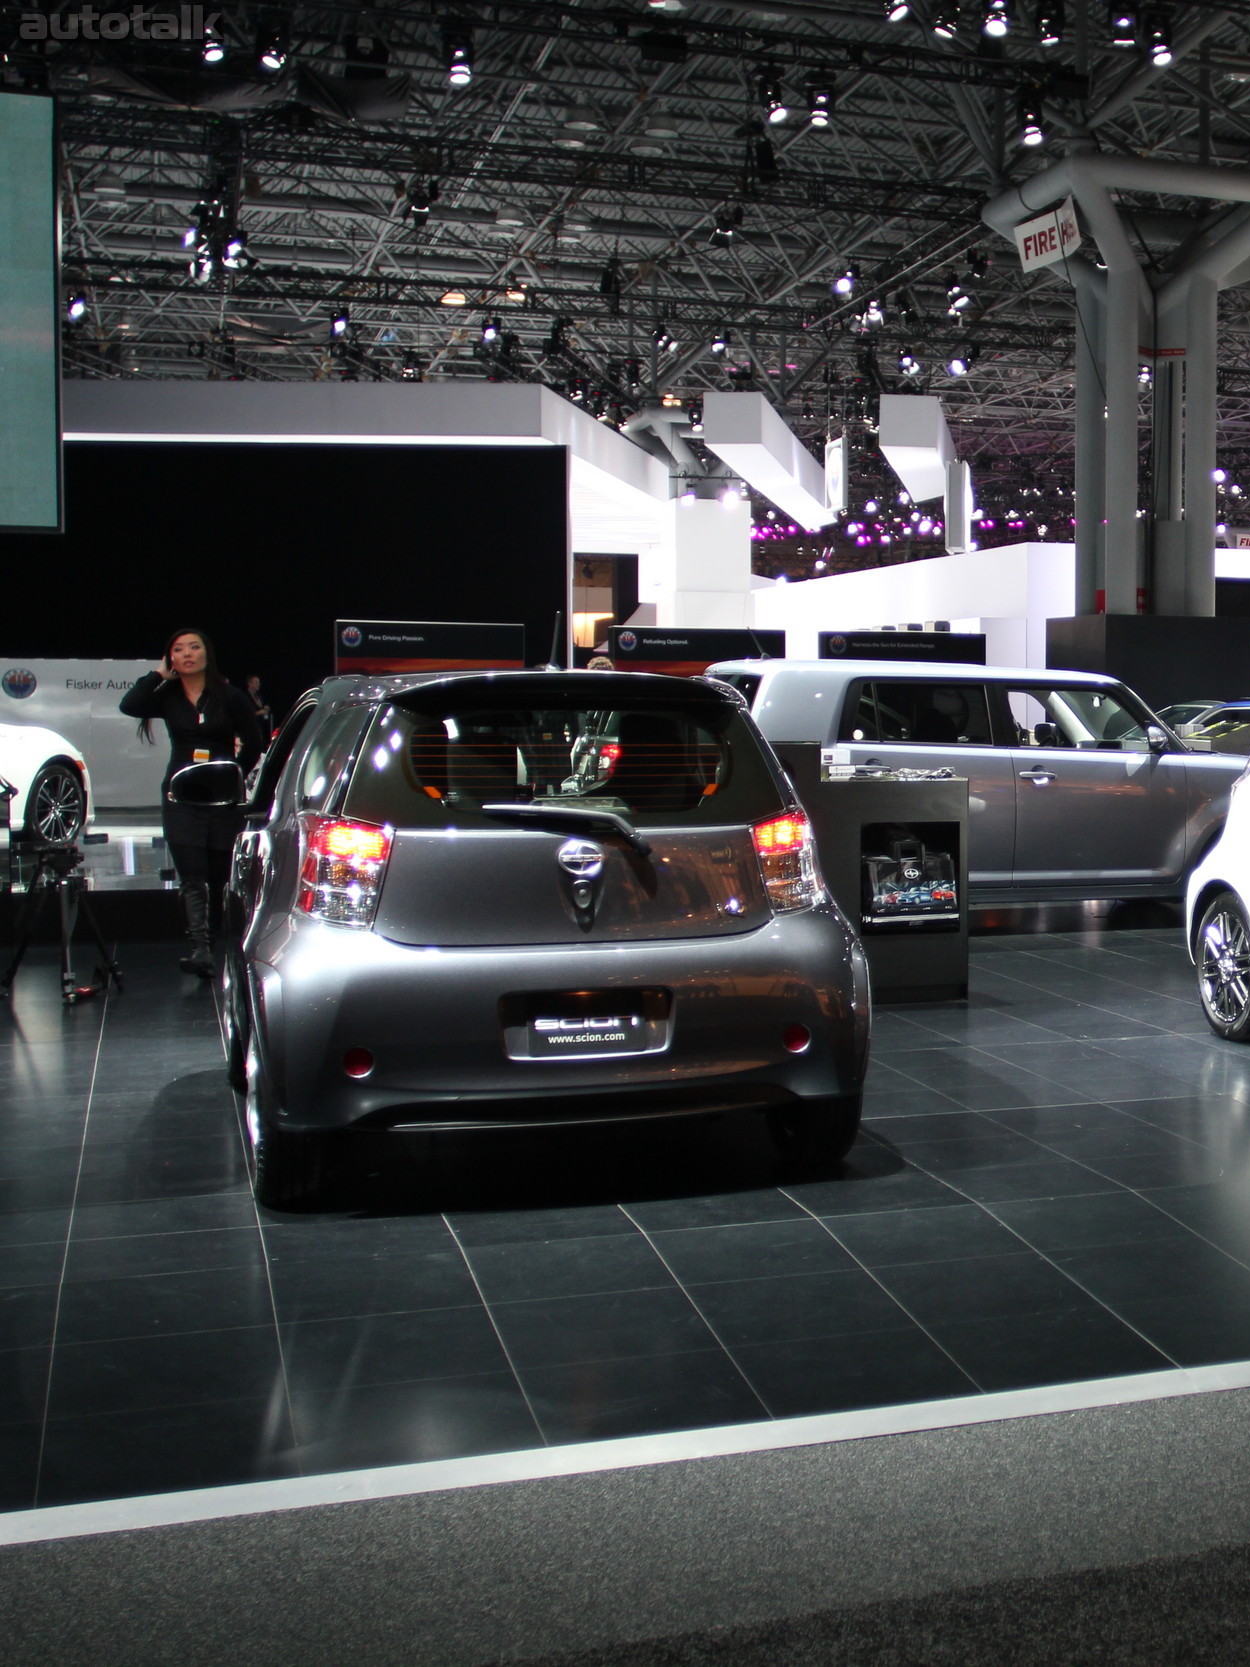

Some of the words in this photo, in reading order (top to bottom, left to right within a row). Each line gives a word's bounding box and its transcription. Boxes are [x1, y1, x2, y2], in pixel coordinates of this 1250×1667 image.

[1023, 226, 1057, 260] FIRE
[382, 634, 402, 642] Driving
[66, 679, 103, 690] Fisker
[548, 1032, 625, 1044] www.scion.com
